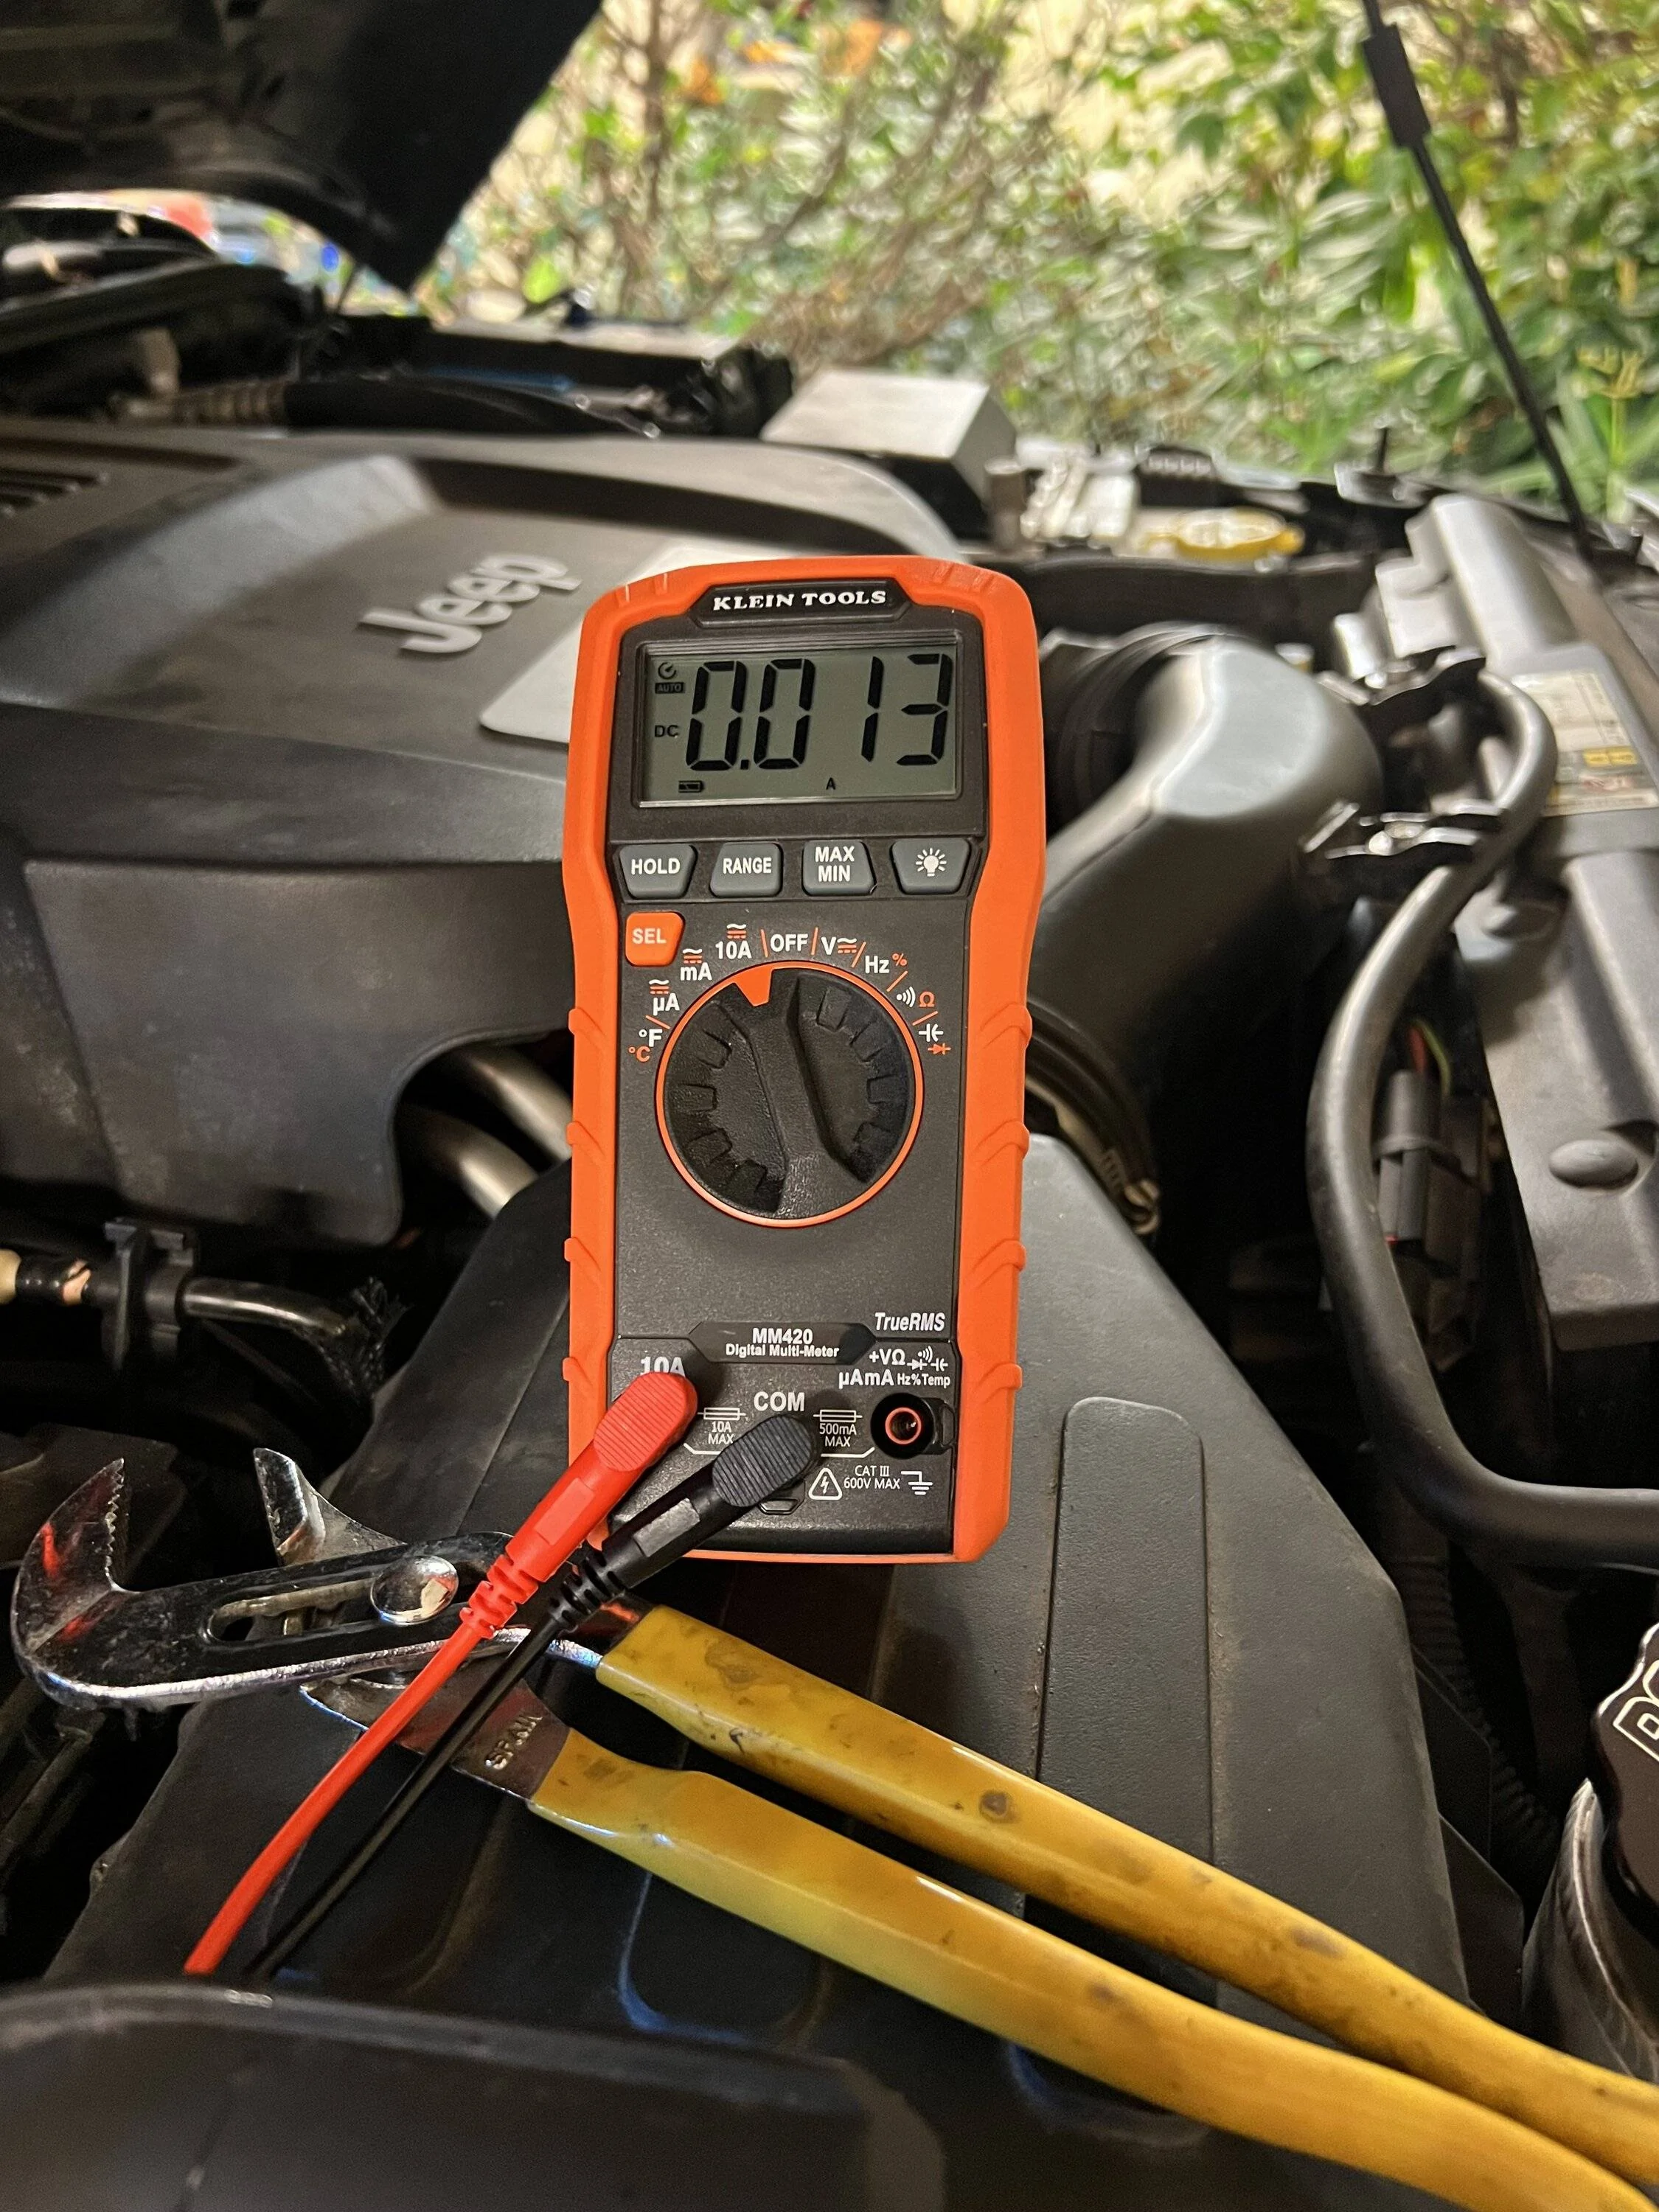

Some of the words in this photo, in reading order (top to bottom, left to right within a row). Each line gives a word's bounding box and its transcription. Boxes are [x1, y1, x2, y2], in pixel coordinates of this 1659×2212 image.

[361, 554, 582, 653] Jeep
[713, 592, 794, 611] KLEIN
[801, 591, 886, 607] TOOLS
[656, 683, 684, 693] AUTO
[686, 653, 953, 771] 0.013
[655, 725, 679, 737] DC
[826, 778, 836, 790] A
[815, 846, 855, 862] MAX
[630, 858, 681, 875] HOLD
[723, 858, 772, 874] RANGE
[818, 866, 851, 882] MIN
[632, 929, 667, 944] SEL
[771, 934, 808, 953] OFF
[715, 941, 752, 959] 10A
[680, 961, 712, 981] mA
[865, 956, 889, 973] Hz
[874, 1312, 946, 1332] TrueRMS
[752, 1328, 813, 1344] MM420
[726, 1343, 766, 1358] Digital
[769, 1343, 840, 1359] Multi-Meter
[640, 1356, 686, 1377] 10A
[754, 1391, 804, 1411] COM
[712, 1421, 732, 1433] 10A
[819, 1423, 857, 1436] 500mA
[708, 1433, 735, 1444] MAX
[825, 1436, 851, 1447] MAX
[855, 1465, 877, 1477] CAT
[844, 1478, 872, 1489] 600V
[874, 1477, 900, 1489] MAX
